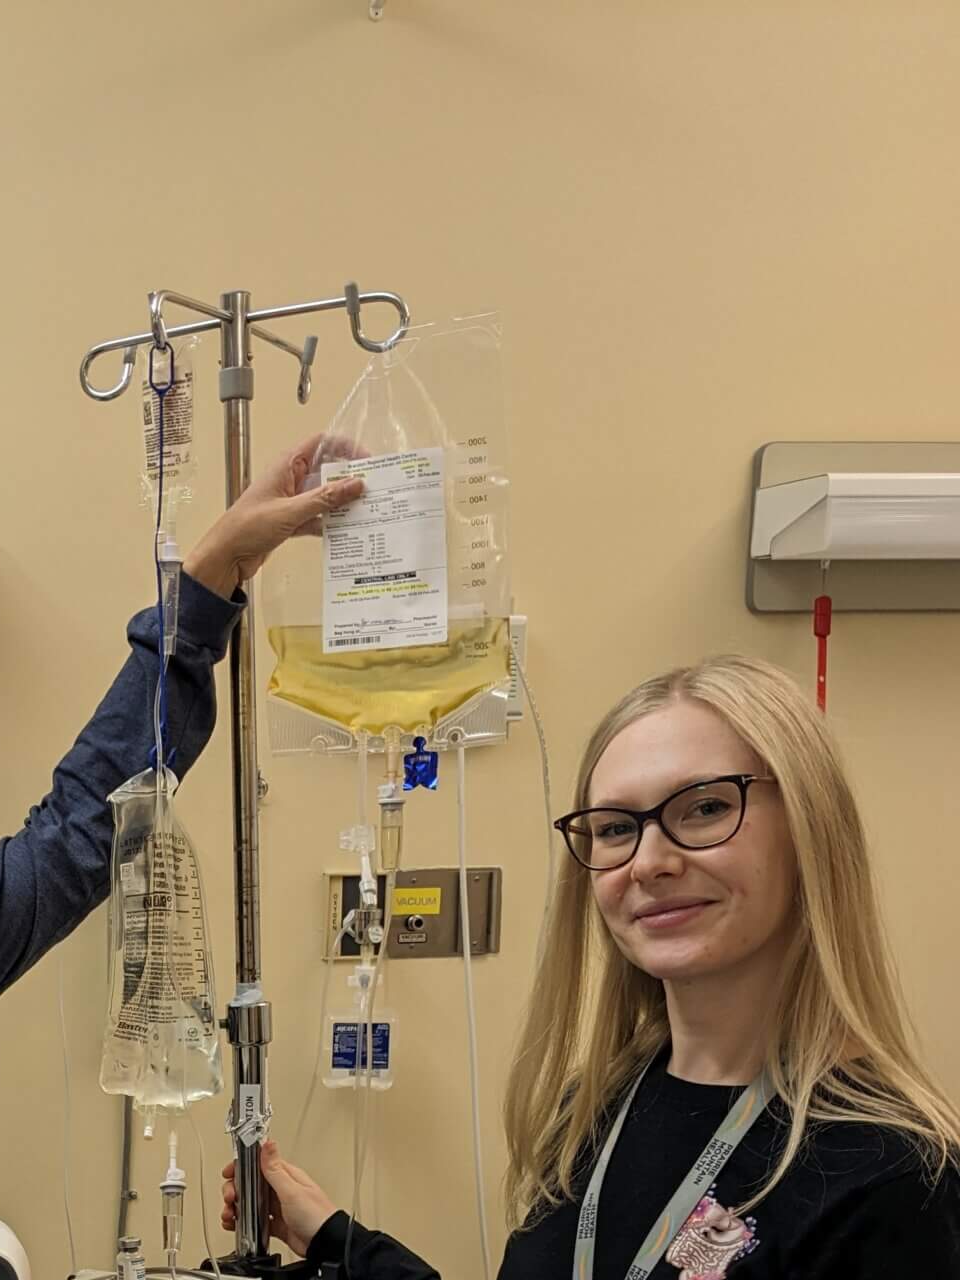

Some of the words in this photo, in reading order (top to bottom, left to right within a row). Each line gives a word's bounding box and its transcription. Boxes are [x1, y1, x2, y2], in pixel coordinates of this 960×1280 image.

[396, 897, 437, 906] VACUUM
[693, 1141, 727, 1185] MOUNTAIN
[695, 1138, 720, 1171] HEALTH
[708, 1143, 733, 1177] PRAIRIE
